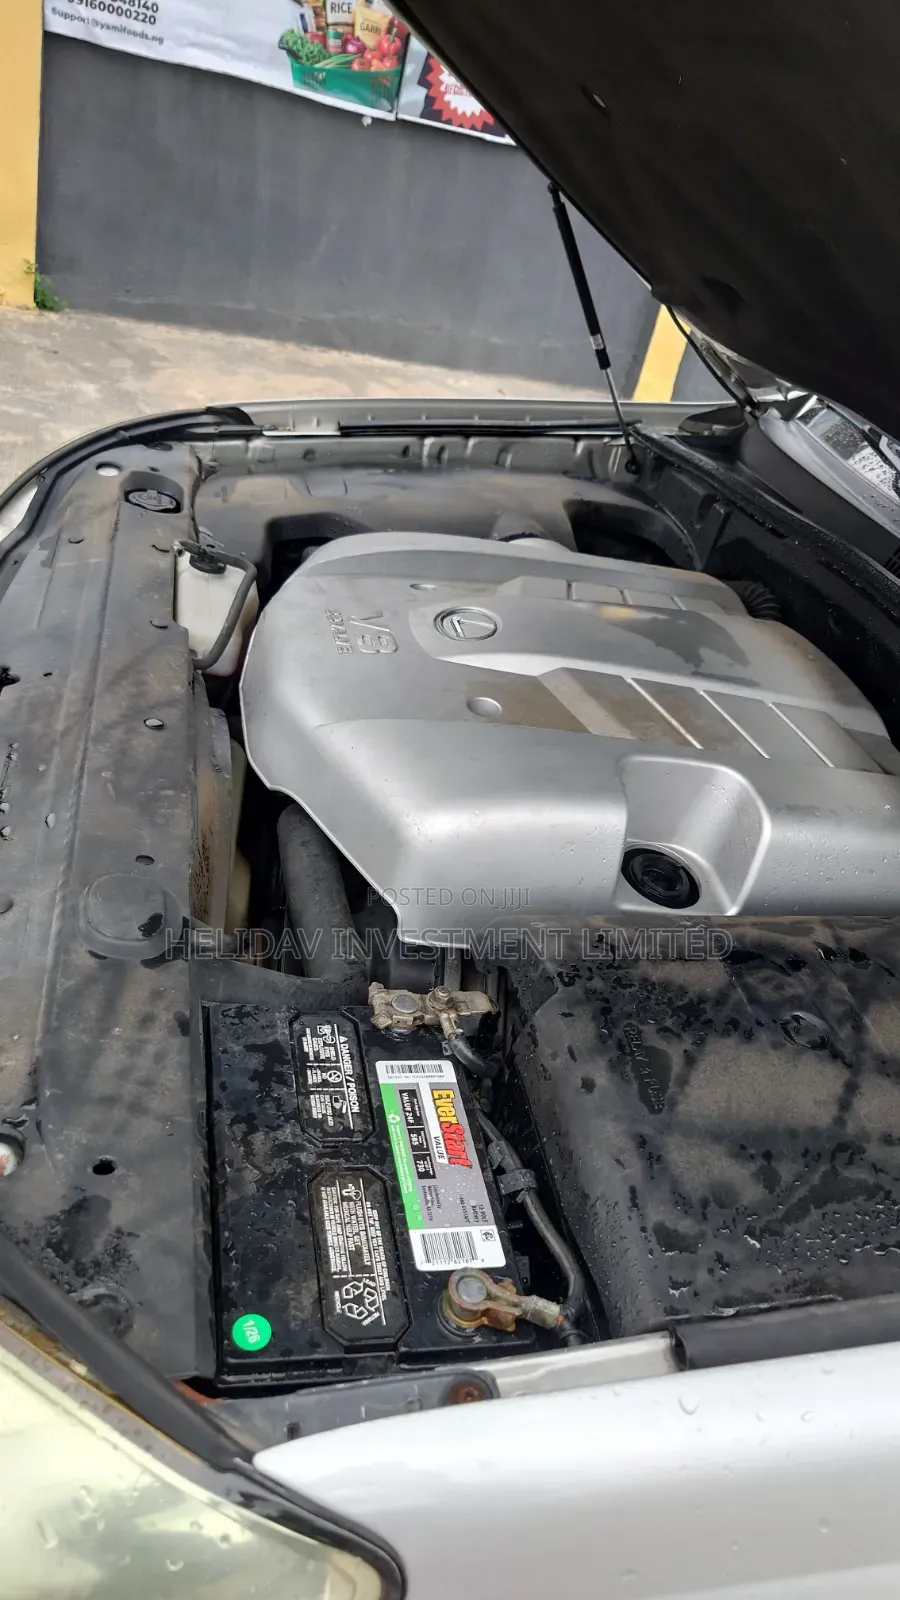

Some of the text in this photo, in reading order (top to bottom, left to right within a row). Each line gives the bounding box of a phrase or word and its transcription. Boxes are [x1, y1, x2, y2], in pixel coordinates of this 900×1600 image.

[330, 2, 353, 14] RICE
[348, 609, 400, 654] V8
[340, 1043, 353, 1075] DANGER
[346, 1082, 359, 1112] POISON
[401, 1091, 414, 1123] VALUE 24F
[410, 1133, 419, 1145] 585
[430, 1088, 472, 1166] EverStart
[433, 1135, 445, 1159] VALUE
[416, 1160, 425, 1172] 730
[341, 1201, 355, 1251] MEDICAL HELP FAST
[354, 1200, 371, 1265] FLUSH EYES IMMEDIATELY
[243, 1320, 261, 1344] 1/26
